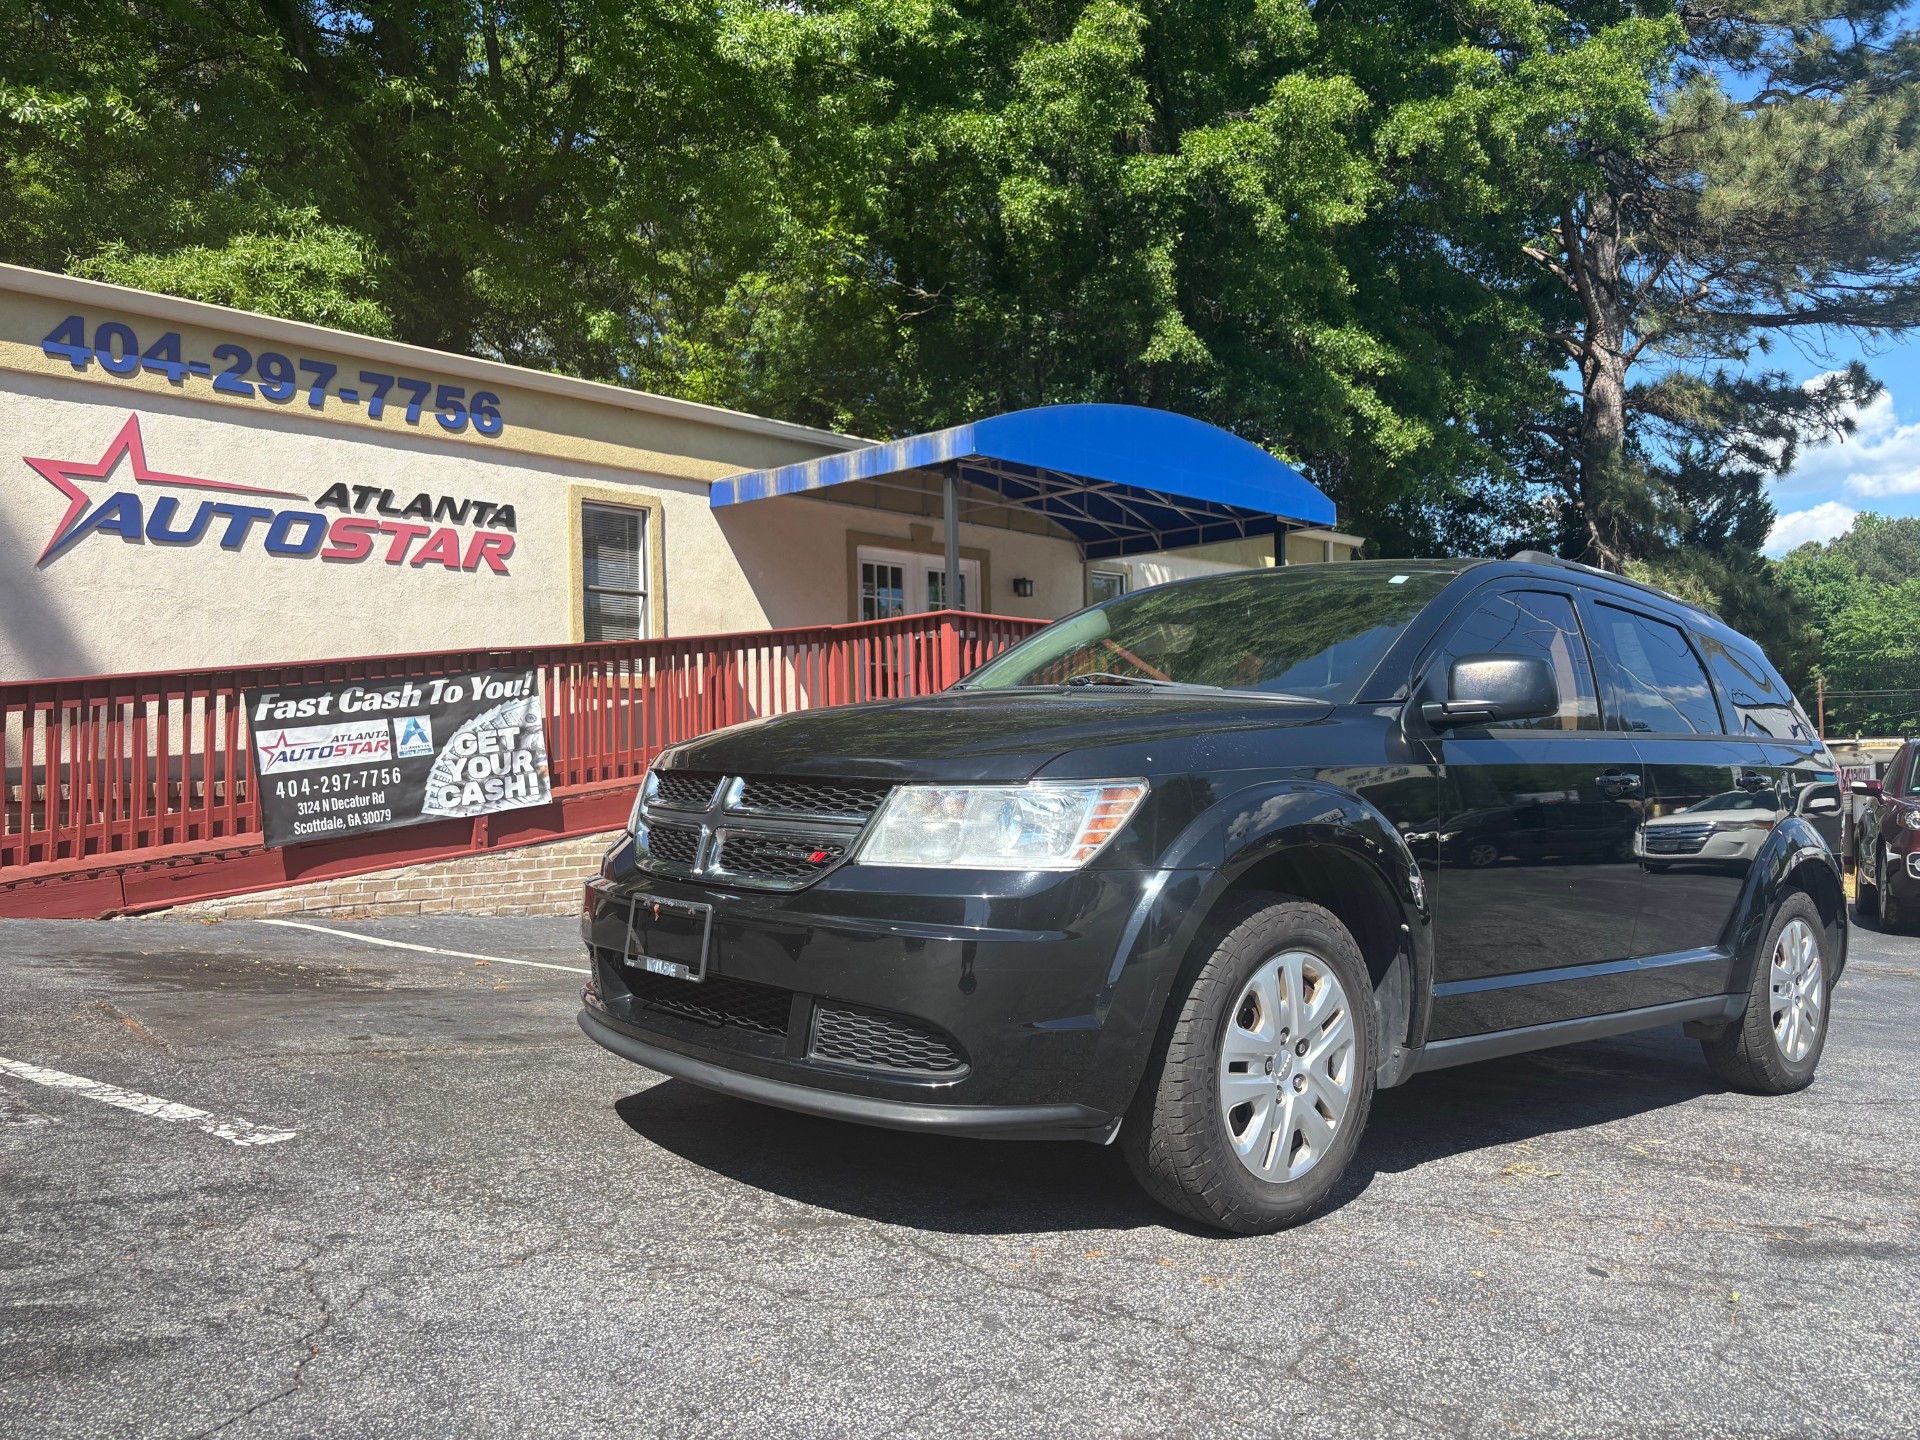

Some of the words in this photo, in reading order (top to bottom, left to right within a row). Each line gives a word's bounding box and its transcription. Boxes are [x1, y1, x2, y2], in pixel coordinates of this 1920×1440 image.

[41, 315, 503, 435] 404-297-7756
[314, 482, 516, 529] ATLANTA
[38, 491, 516, 575] AUTOSTAR
[255, 692, 333, 721] Fast
[339, 682, 422, 713] Cash
[429, 678, 464, 705] To
[471, 670, 533, 700] You!
[330, 730, 389, 743] ATLANTA
[453, 726, 520, 756] GET
[267, 739, 390, 768] AUTOSTAR
[443, 750, 534, 782] YOUR
[276, 767, 402, 799] 404-297-7756
[437, 772, 539, 808] CASH!
[297, 800, 320, 815] 3124
[322, 799, 330, 812] N
[332, 795, 370, 810] Decatur
[372, 791, 385, 805] Rd
[293, 815, 346, 835] Scottdale,
[347, 813, 361, 827] GA
[362, 809, 392, 824] 30079
